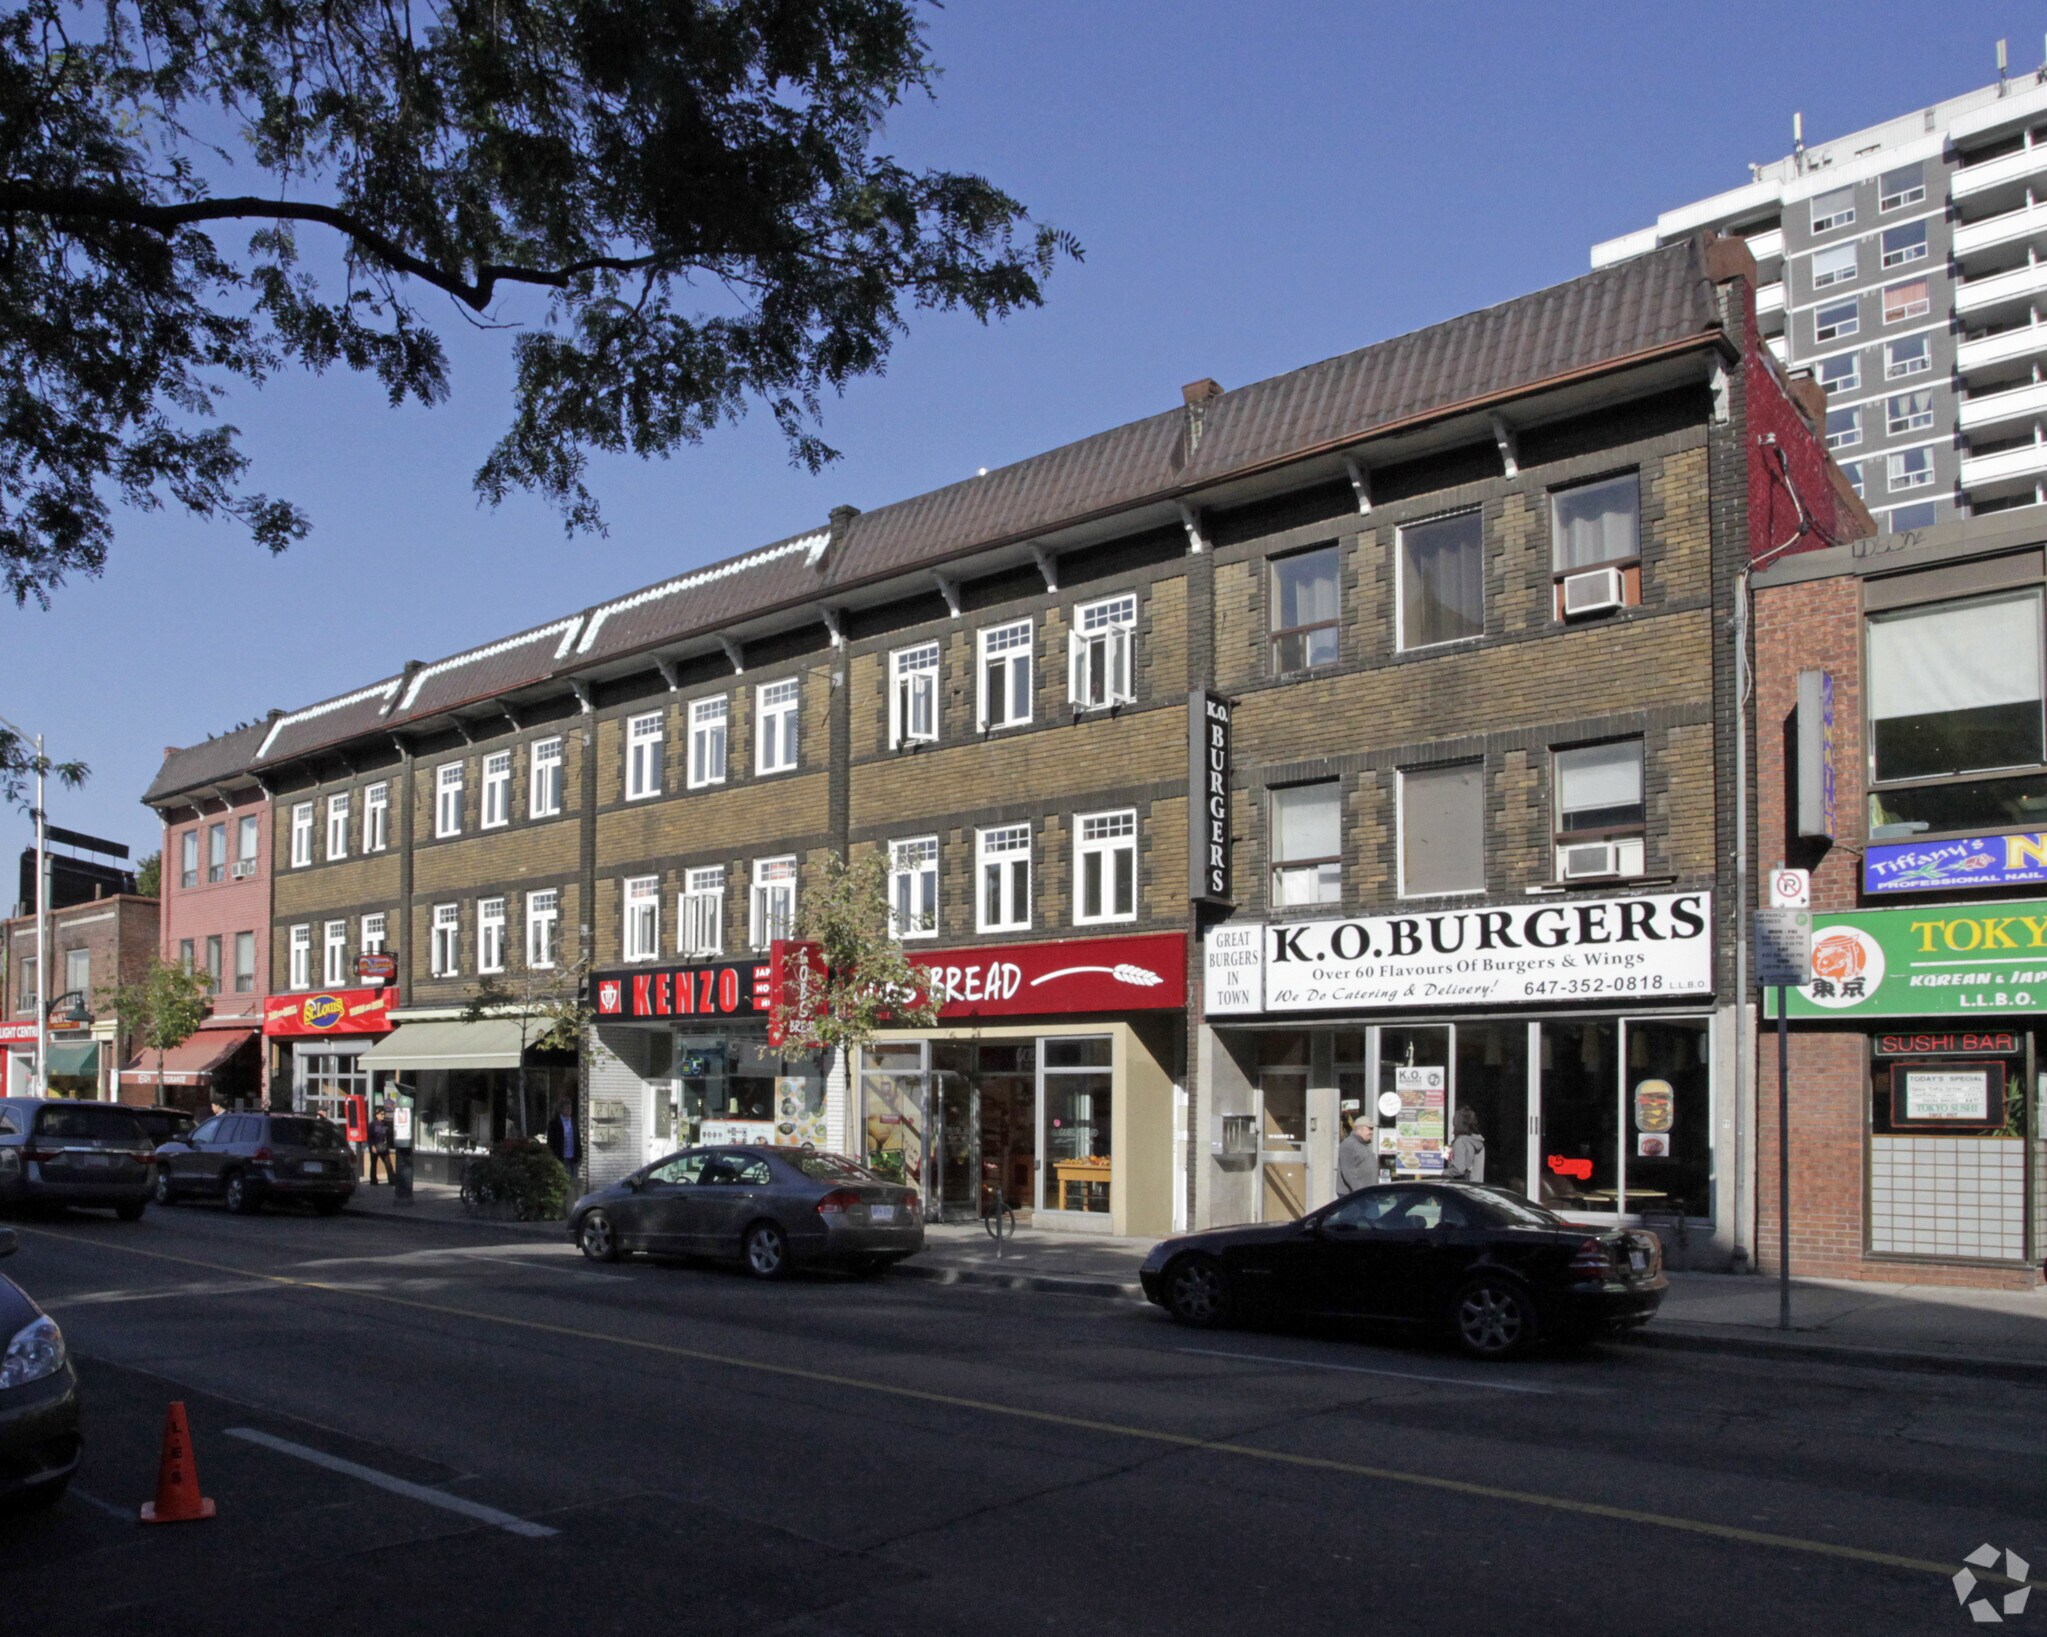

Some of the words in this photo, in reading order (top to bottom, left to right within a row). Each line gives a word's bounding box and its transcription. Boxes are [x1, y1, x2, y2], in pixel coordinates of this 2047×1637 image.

[1206, 701, 1228, 722] K.O.
[1210, 724, 1225, 892] BURGERS
[1870, 838, 1985, 876] Tiffany's
[1877, 874, 2001, 890] PROFESSIONAL
[2005, 872, 2044, 881] NAIL
[1216, 931, 1251, 948] GREAT
[1209, 950, 1258, 968] BURGERS
[1312, 968, 1350, 980] Over
[1355, 967, 1374, 978] 60
[1379, 964, 1453, 978] Flavours
[1457, 959, 1478, 973] Of
[1482, 958, 1555, 975] Burgers
[1561, 954, 1578, 967] &
[1584, 952, 1645, 968] Wings
[930, 961, 1021, 1003] BREAD
[1227, 971, 1239, 986] IN
[1525, 975, 1663, 996] 647-352-0818
[1669, 981, 1708, 990] L.L.B.O.
[1910, 972, 1992, 987] KOREAN
[633, 968, 738, 1016] KENZO
[1217, 990, 1250, 1005] TOWN
[1274, 990, 1299, 1002] We
[1306, 988, 1327, 1001] Do
[1332, 987, 1397, 1002] Catering
[1403, 983, 1416, 996] &
[1423, 979, 1499, 997] Delivery!
[1960, 992, 2036, 1007] L.L.B.O.
[1883, 1035, 1954, 1052] SUSHI
[1963, 1034, 2012, 1050] BAR
[1917, 1104, 1948, 1113] TOKYO
[1950, 1103, 1978, 1113] SUSHI
